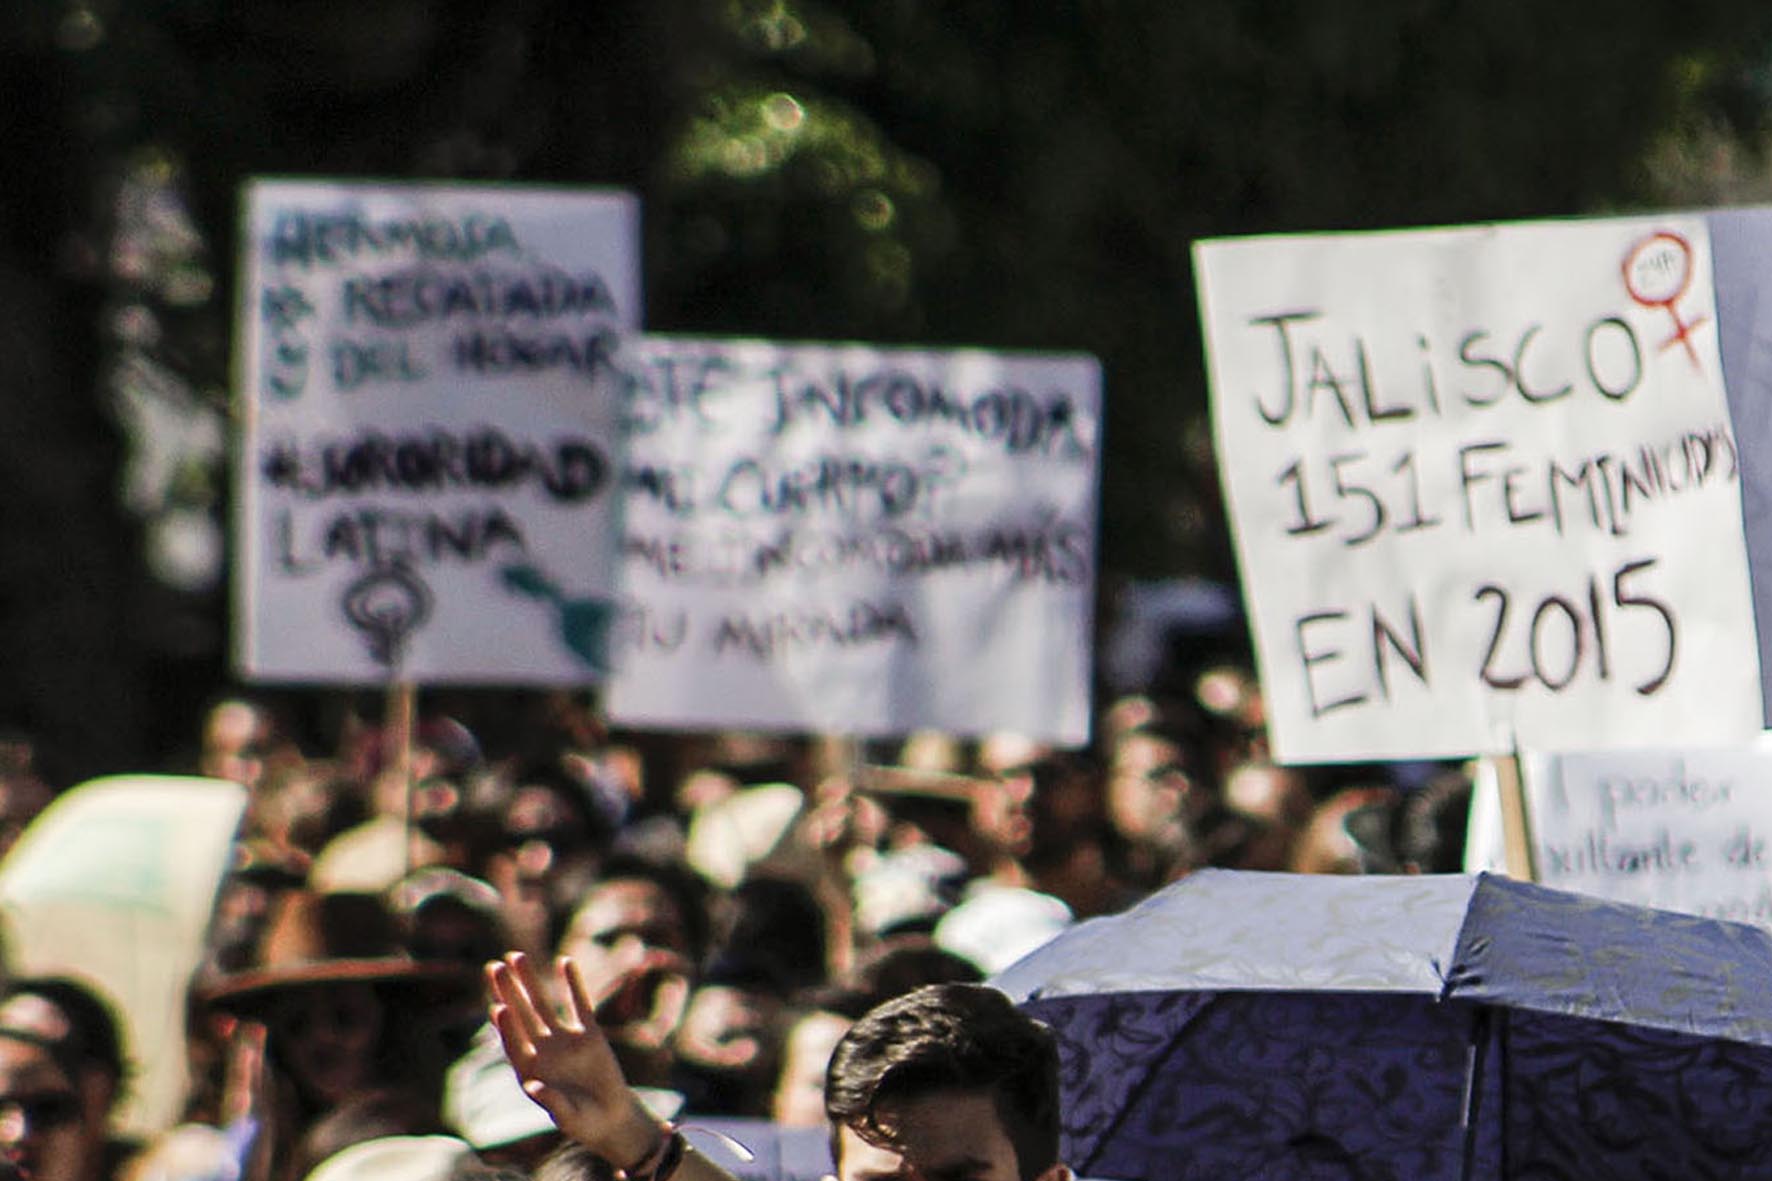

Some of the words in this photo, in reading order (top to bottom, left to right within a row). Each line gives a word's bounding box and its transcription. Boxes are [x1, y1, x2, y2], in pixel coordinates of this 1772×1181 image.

[1278, 450, 1442, 545] 151
[1297, 592, 1430, 718] EN
[1474, 558, 1676, 695] 2015
[1726, 825, 1767, 866] de
